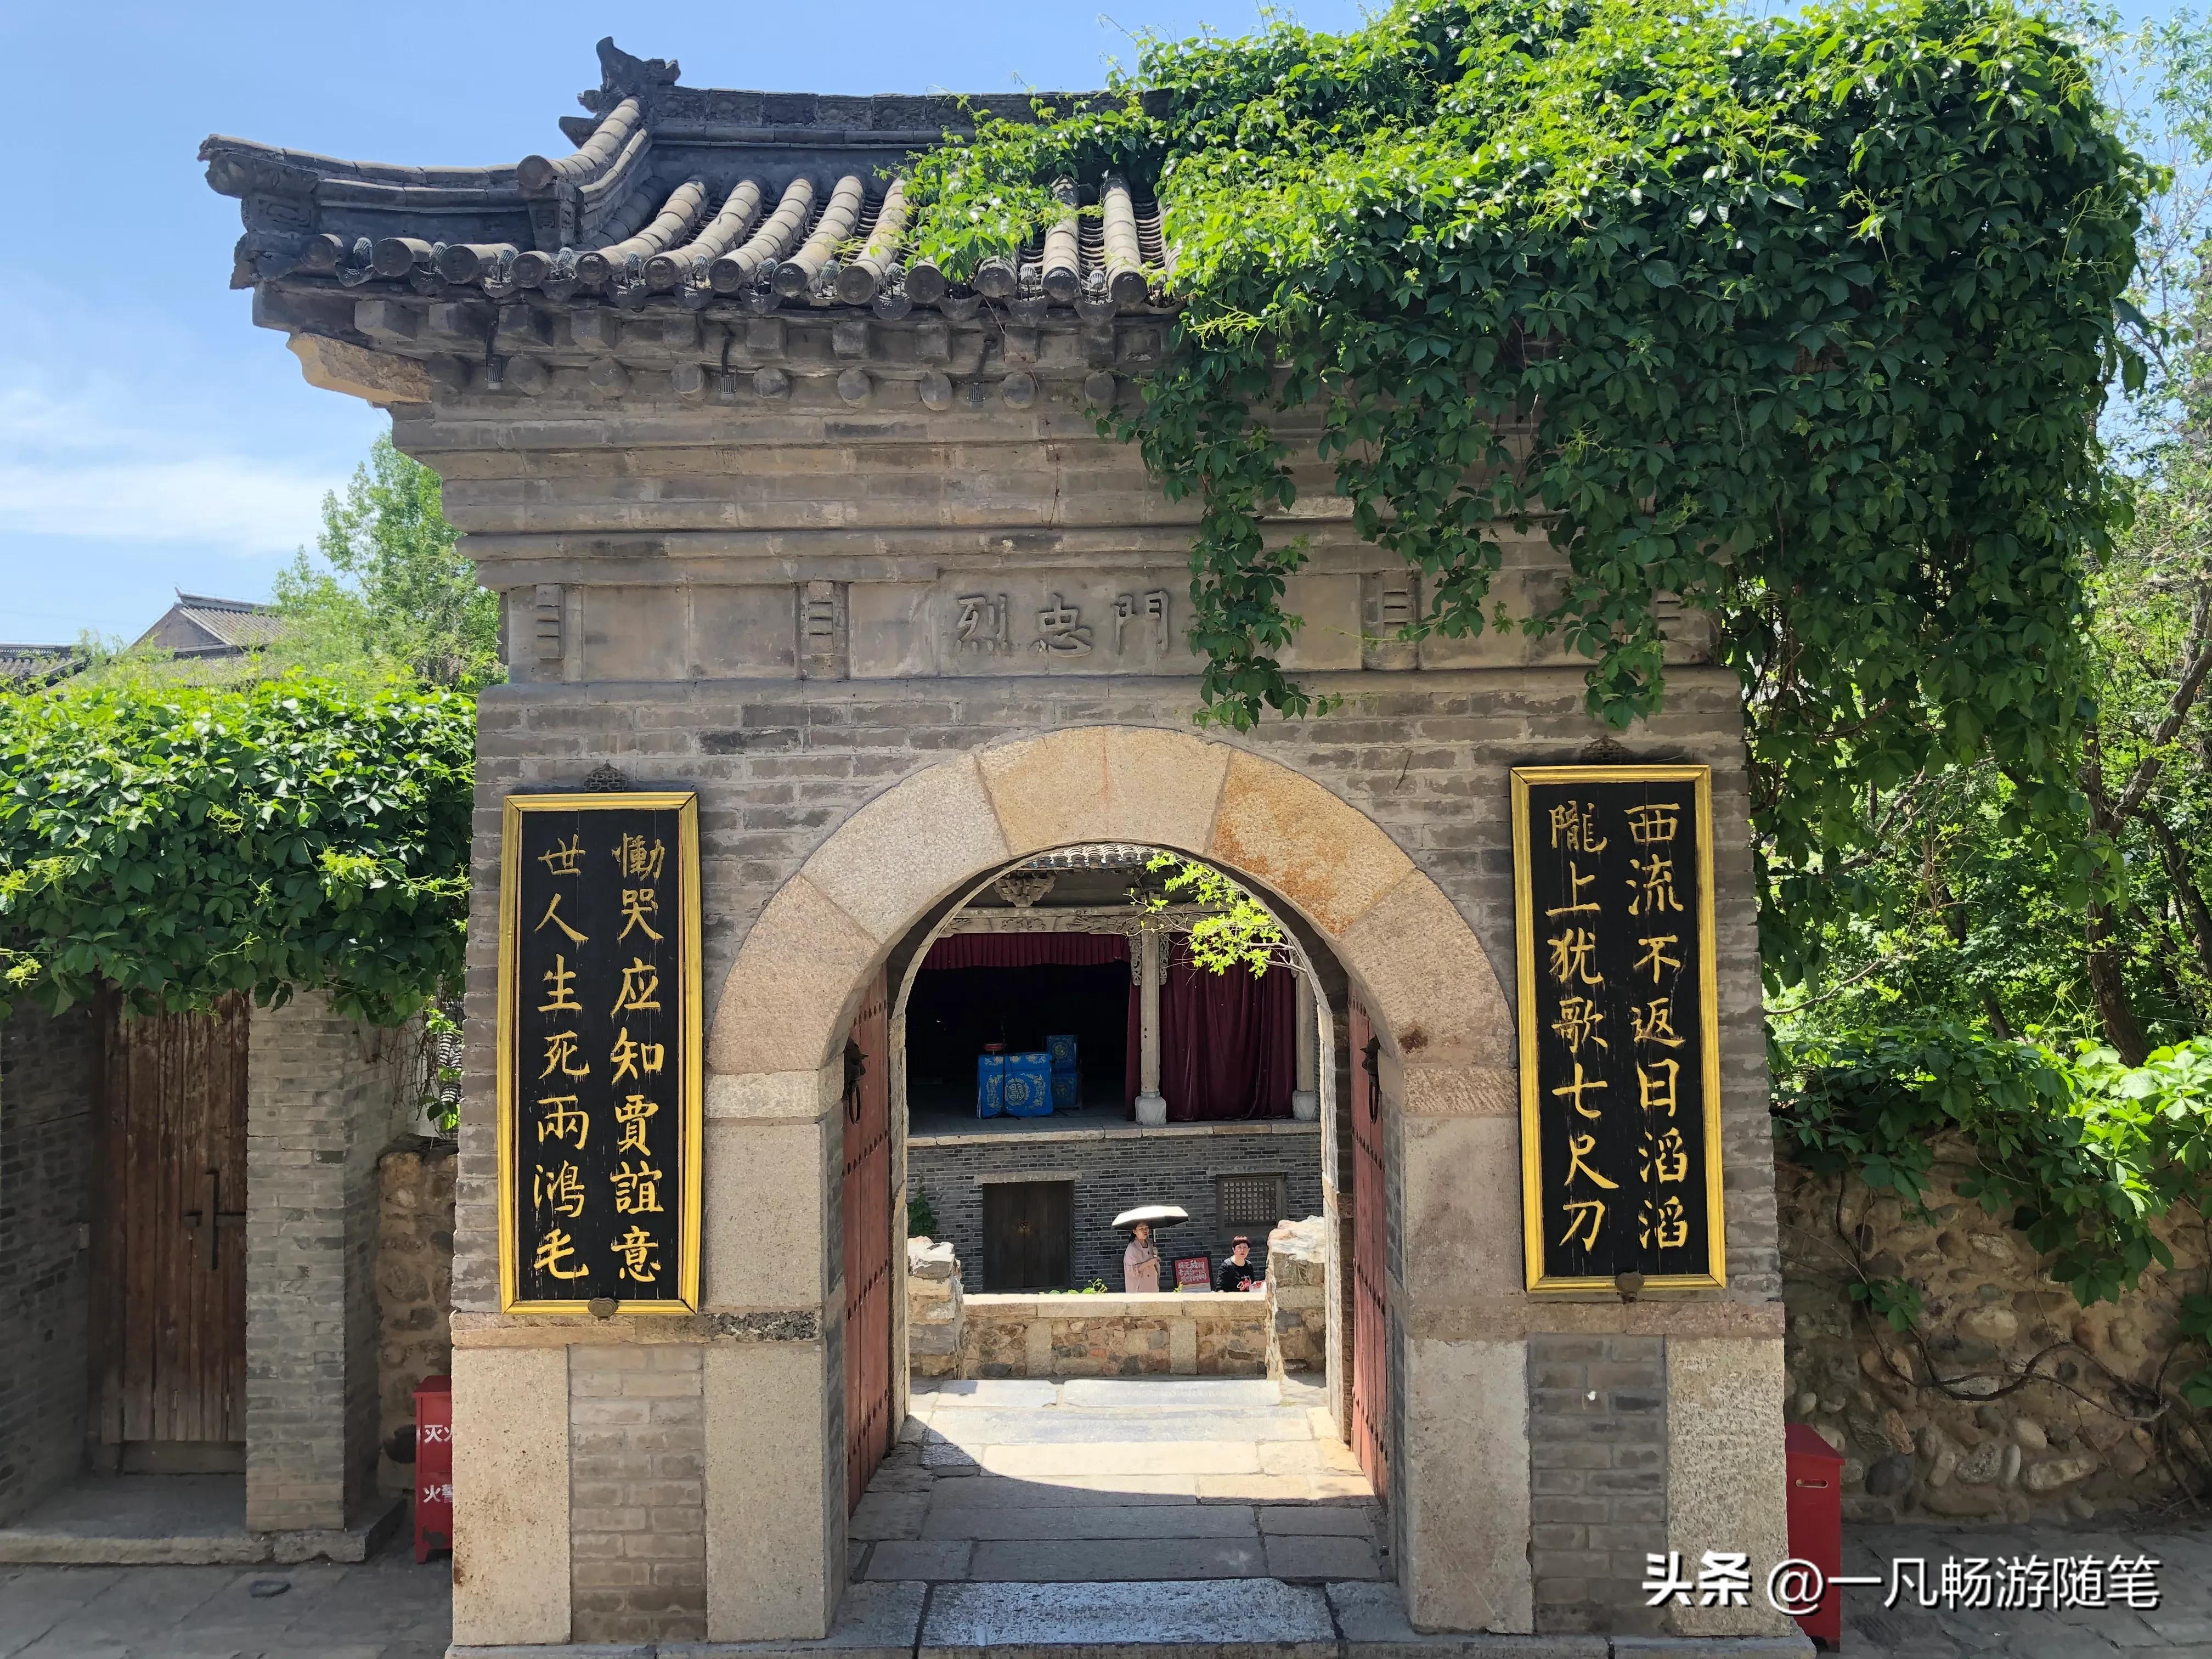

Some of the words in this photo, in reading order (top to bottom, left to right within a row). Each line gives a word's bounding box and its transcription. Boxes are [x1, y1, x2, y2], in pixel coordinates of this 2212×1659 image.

[533, 833, 590, 1280] 世人生死兩鴻毛
[1623, 803, 1688, 1250] 西流不返日滔滔
